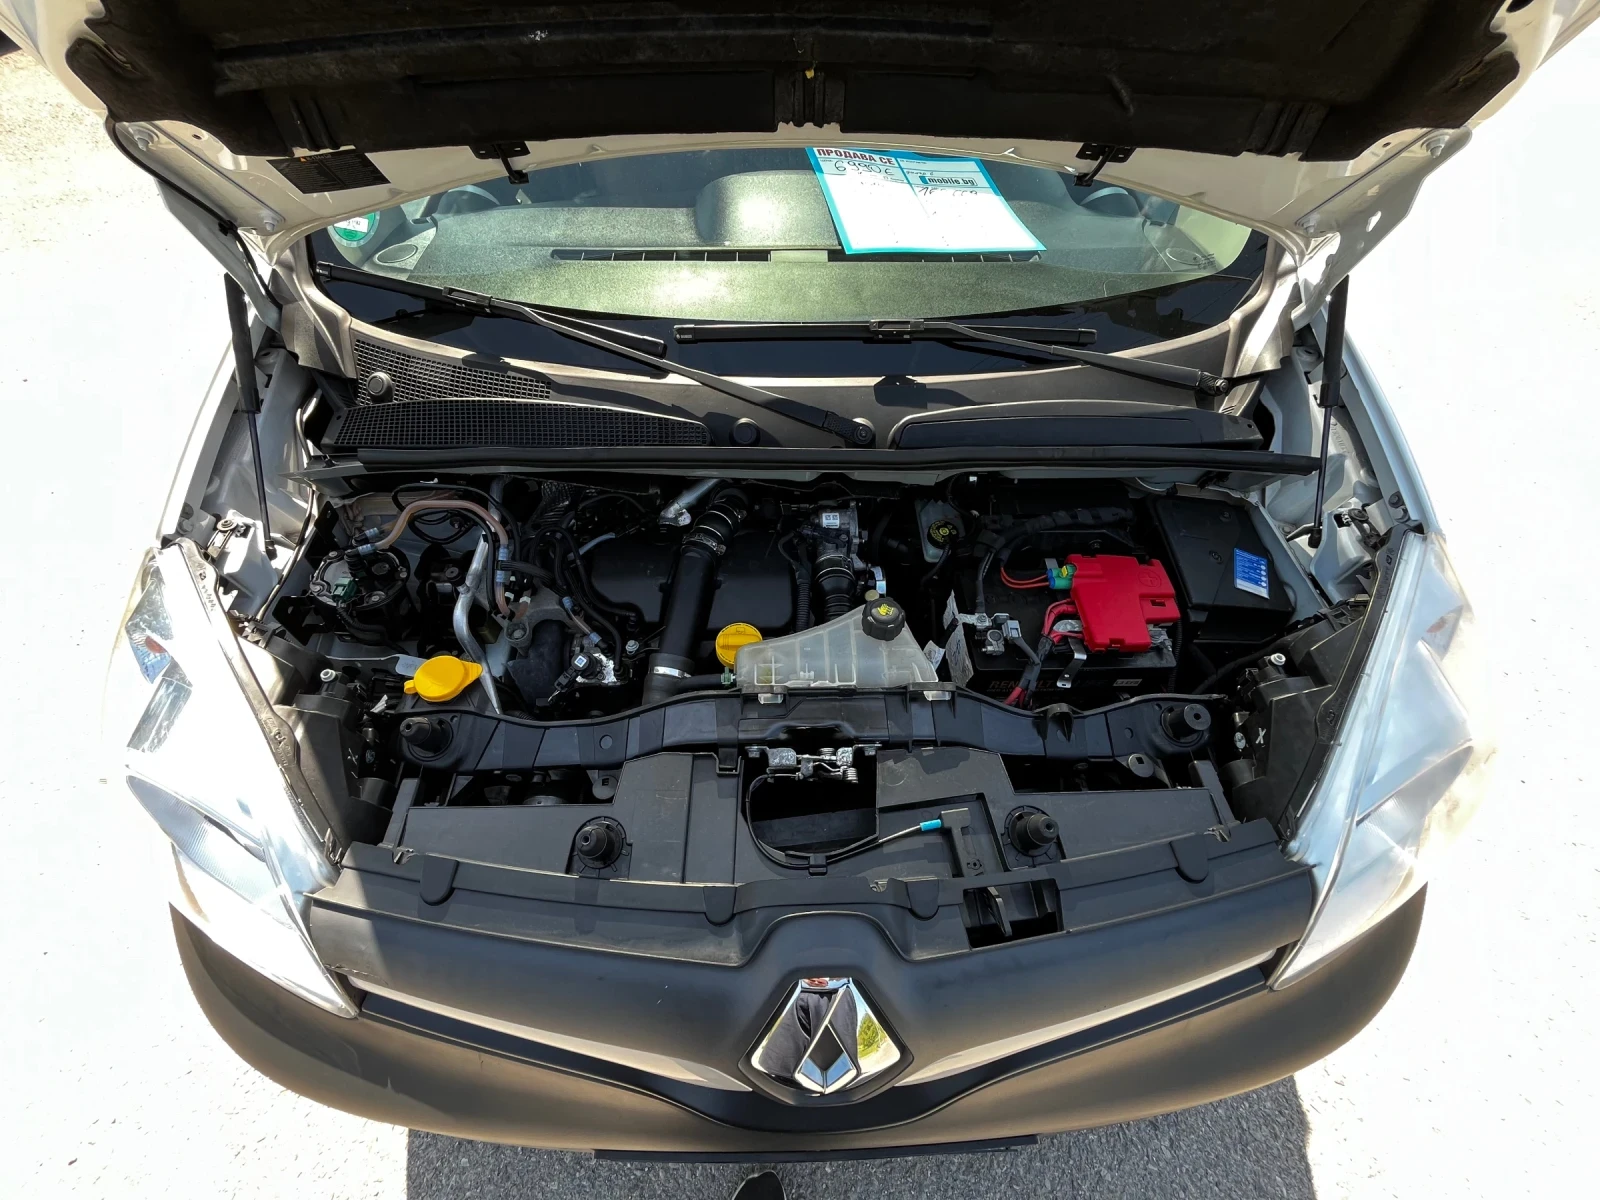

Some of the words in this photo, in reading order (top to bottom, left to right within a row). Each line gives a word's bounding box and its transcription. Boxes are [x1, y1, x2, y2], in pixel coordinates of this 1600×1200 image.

[817, 148, 877, 162] ПРОДАВА
[879, 156, 895, 165] СЕ
[928, 177, 975, 186] mobile.bg
[988, 680, 1055, 688] RENLT
